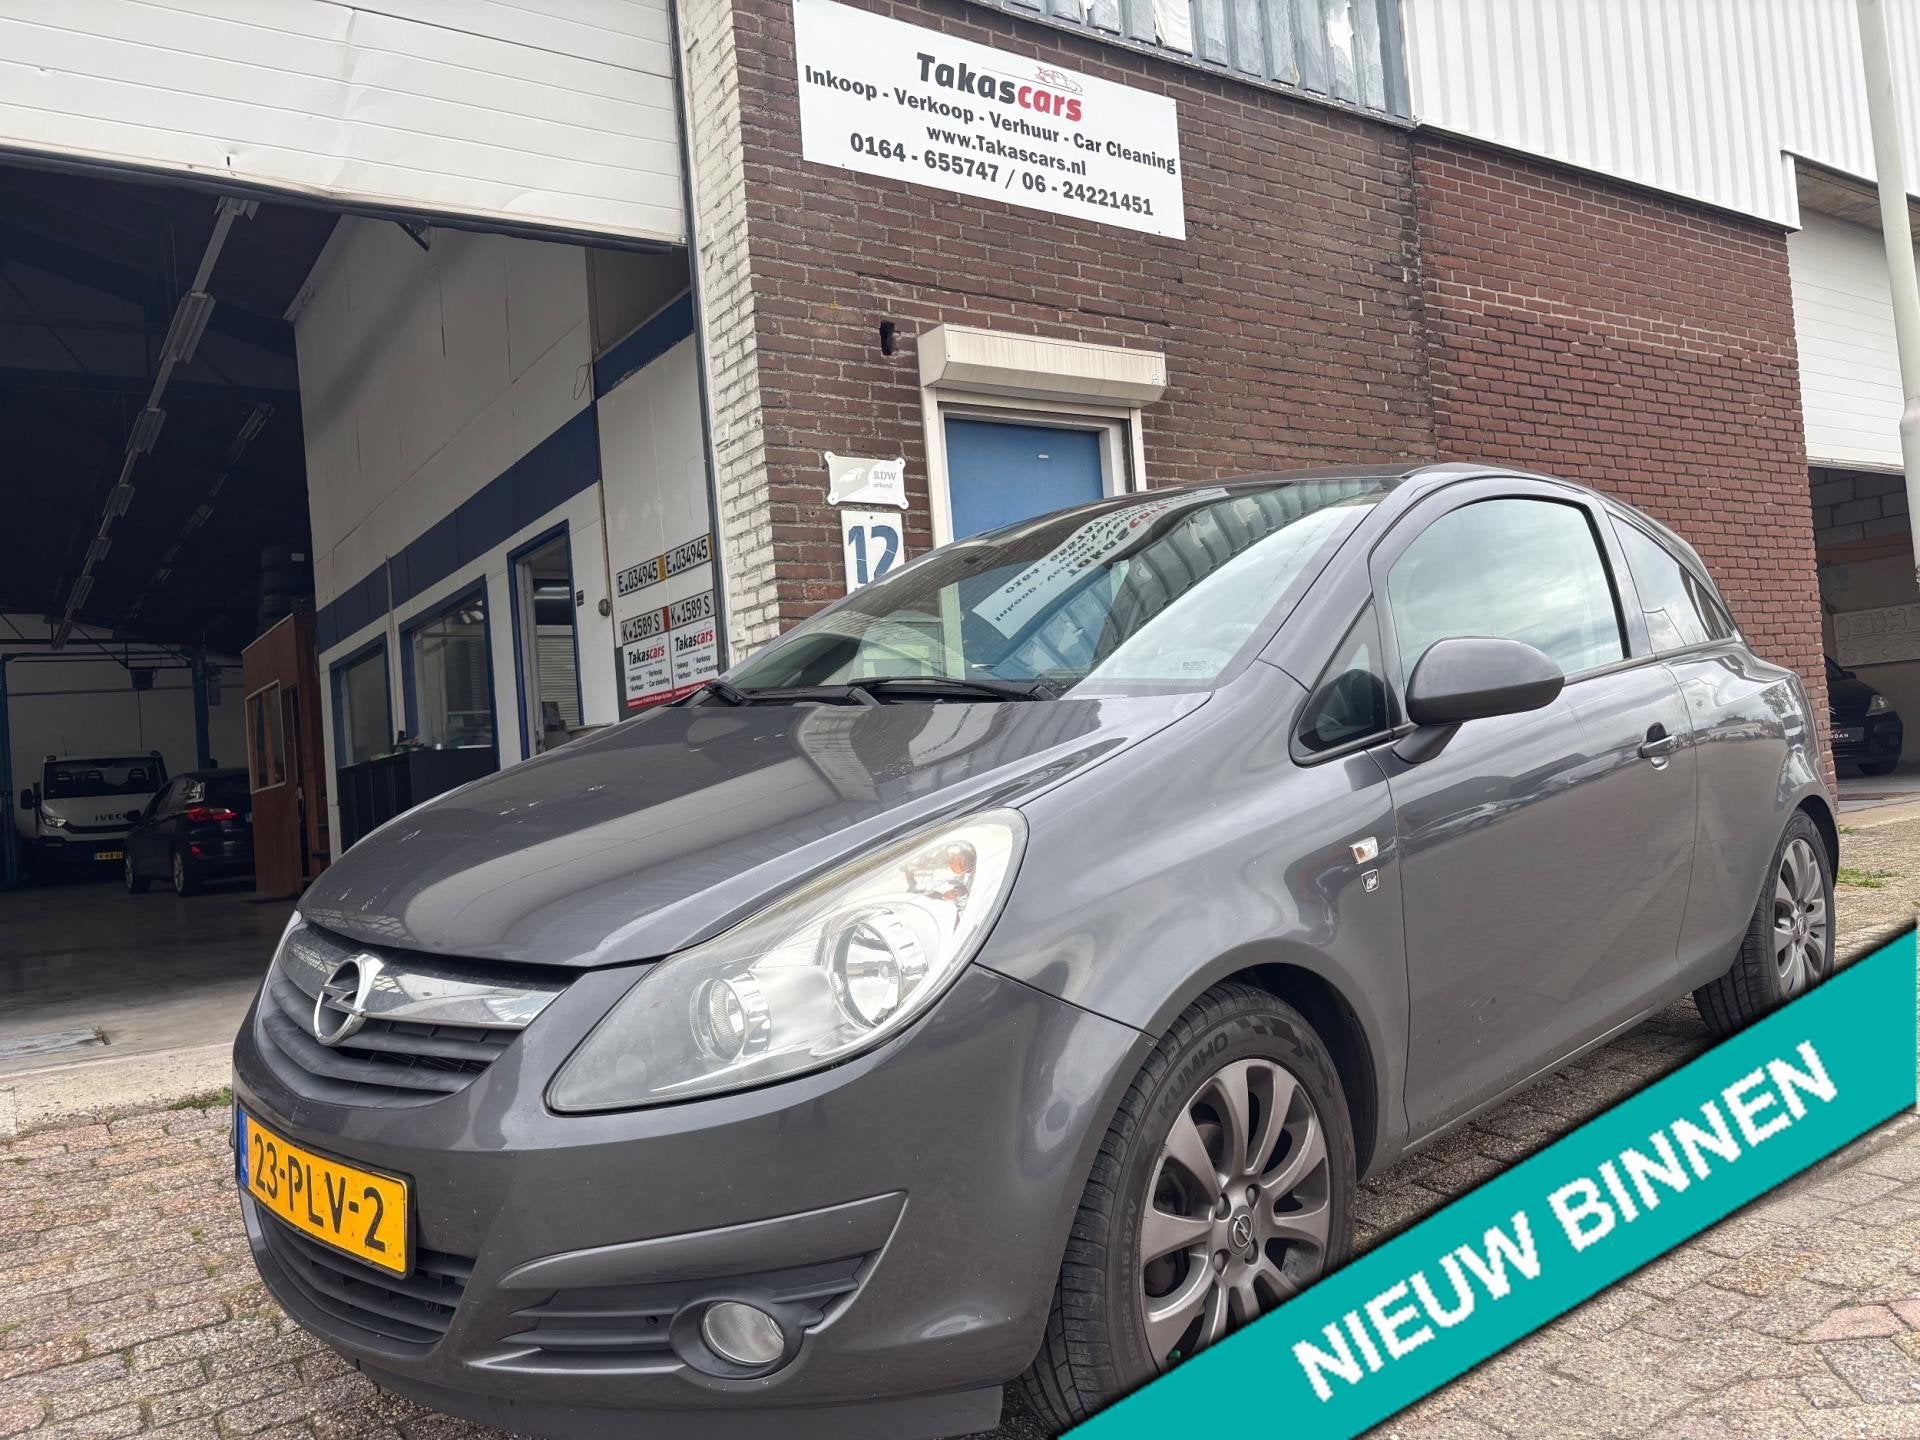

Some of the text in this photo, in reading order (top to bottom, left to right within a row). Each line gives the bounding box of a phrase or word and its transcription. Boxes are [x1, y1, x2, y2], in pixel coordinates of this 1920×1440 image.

[805, 65, 877, 100] Inkoop
[893, 87, 974, 124] Verkoop
[989, 111, 1059, 143] Verhuur
[1074, 132, 1101, 153] Car
[1106, 141, 1176, 174] Cleaning
[916, 52, 1082, 122] Takascars
[850, 132, 906, 163] 0164
[924, 150, 999, 183] 655747
[1022, 171, 1046, 193] 06
[1062, 181, 1154, 216] 24221451
[926, 127, 1087, 176] www.Takascars.nl
[873, 470, 897, 481] RDW
[848, 525, 898, 585] 12
[628, 645, 665, 666] Takascars
[675, 628, 713, 652] Takascars
[1158, 1032, 1229, 1118] KUMHO
[255, 1133, 385, 1252] 23-PLV-2
